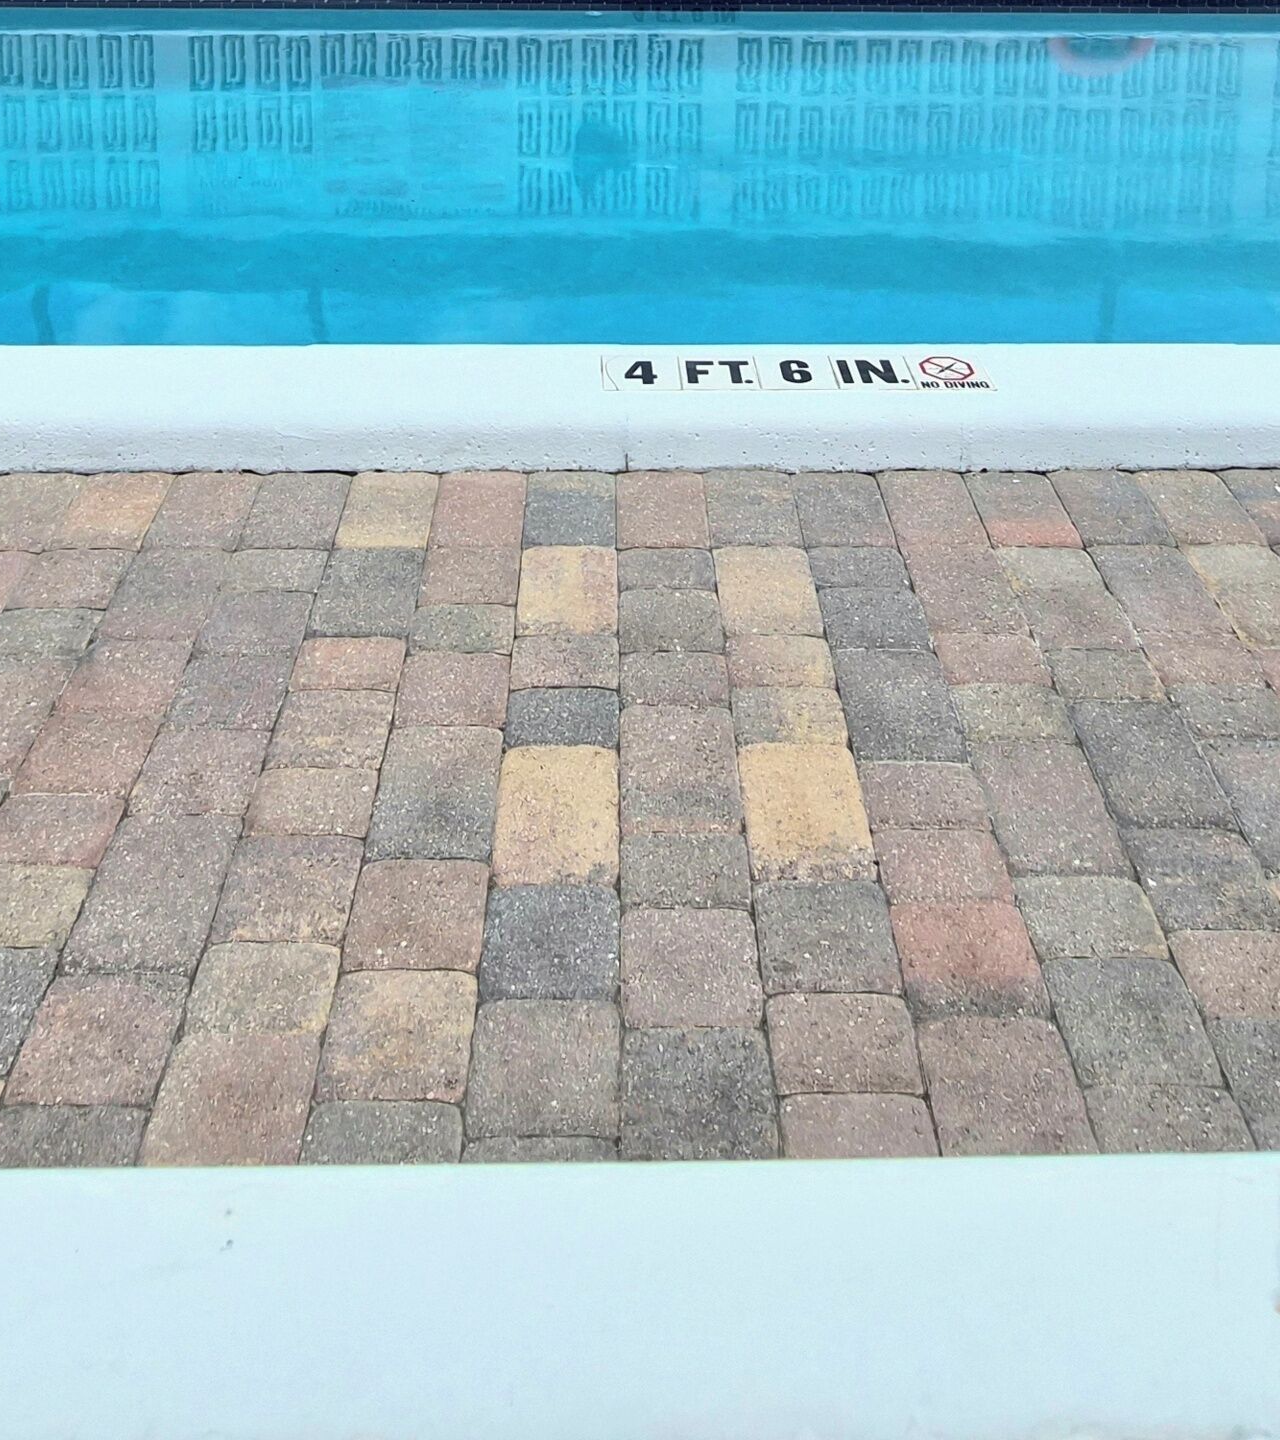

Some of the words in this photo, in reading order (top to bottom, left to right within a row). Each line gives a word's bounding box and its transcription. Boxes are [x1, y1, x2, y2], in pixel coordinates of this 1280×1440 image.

[624, 360, 658, 385] 4
[684, 360, 754, 384] FT.
[779, 360, 813, 384] 6
[836, 359, 910, 384] IN.
[920, 380, 941, 389] NO
[943, 380, 991, 389] DIVING
